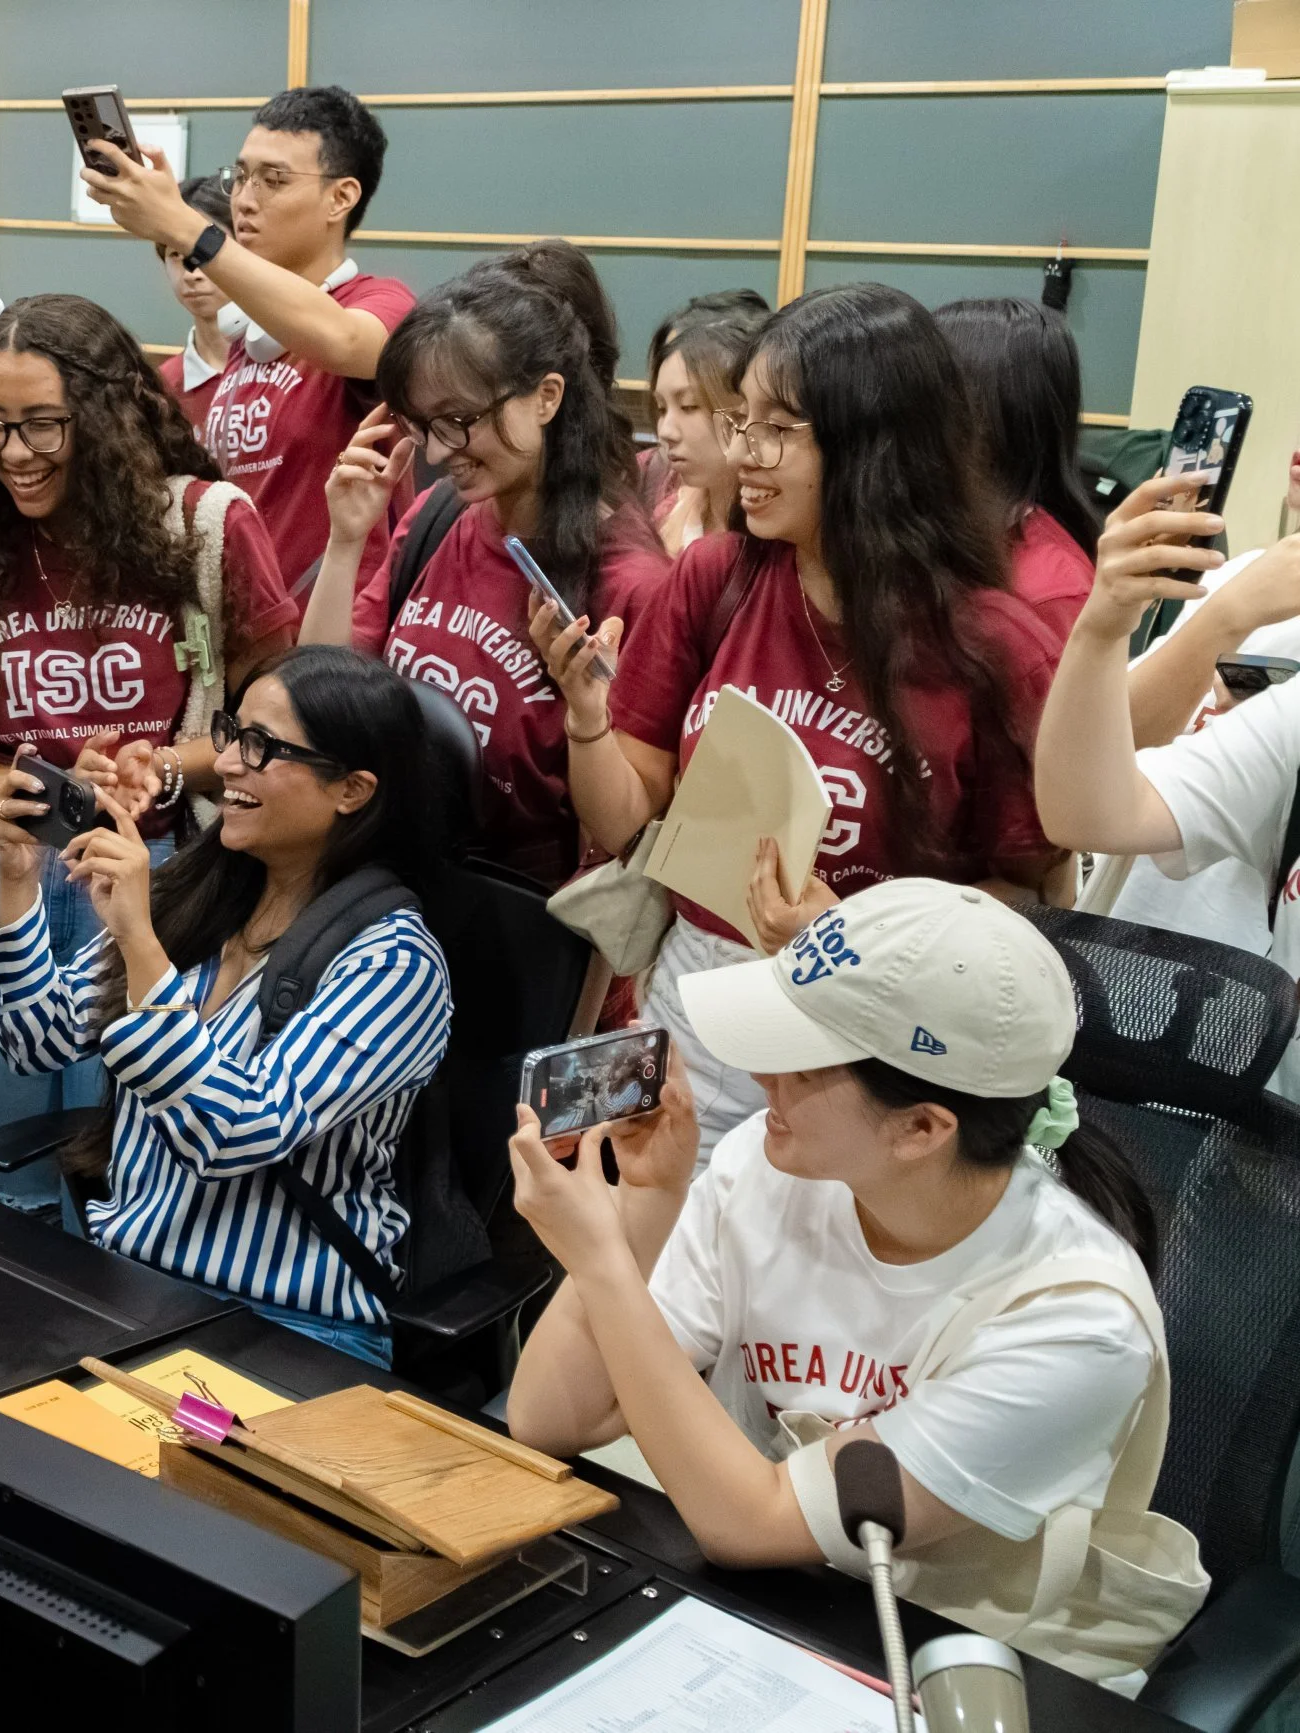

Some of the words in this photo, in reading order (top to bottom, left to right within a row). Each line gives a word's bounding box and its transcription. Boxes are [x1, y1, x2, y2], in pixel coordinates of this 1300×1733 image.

[1, 641, 145, 719] ISC
[447, 604, 556, 705] UNIVERSITY
[785, 928, 834, 986] ory
[816, 917, 862, 968] for
[741, 1341, 826, 1387] OREA
